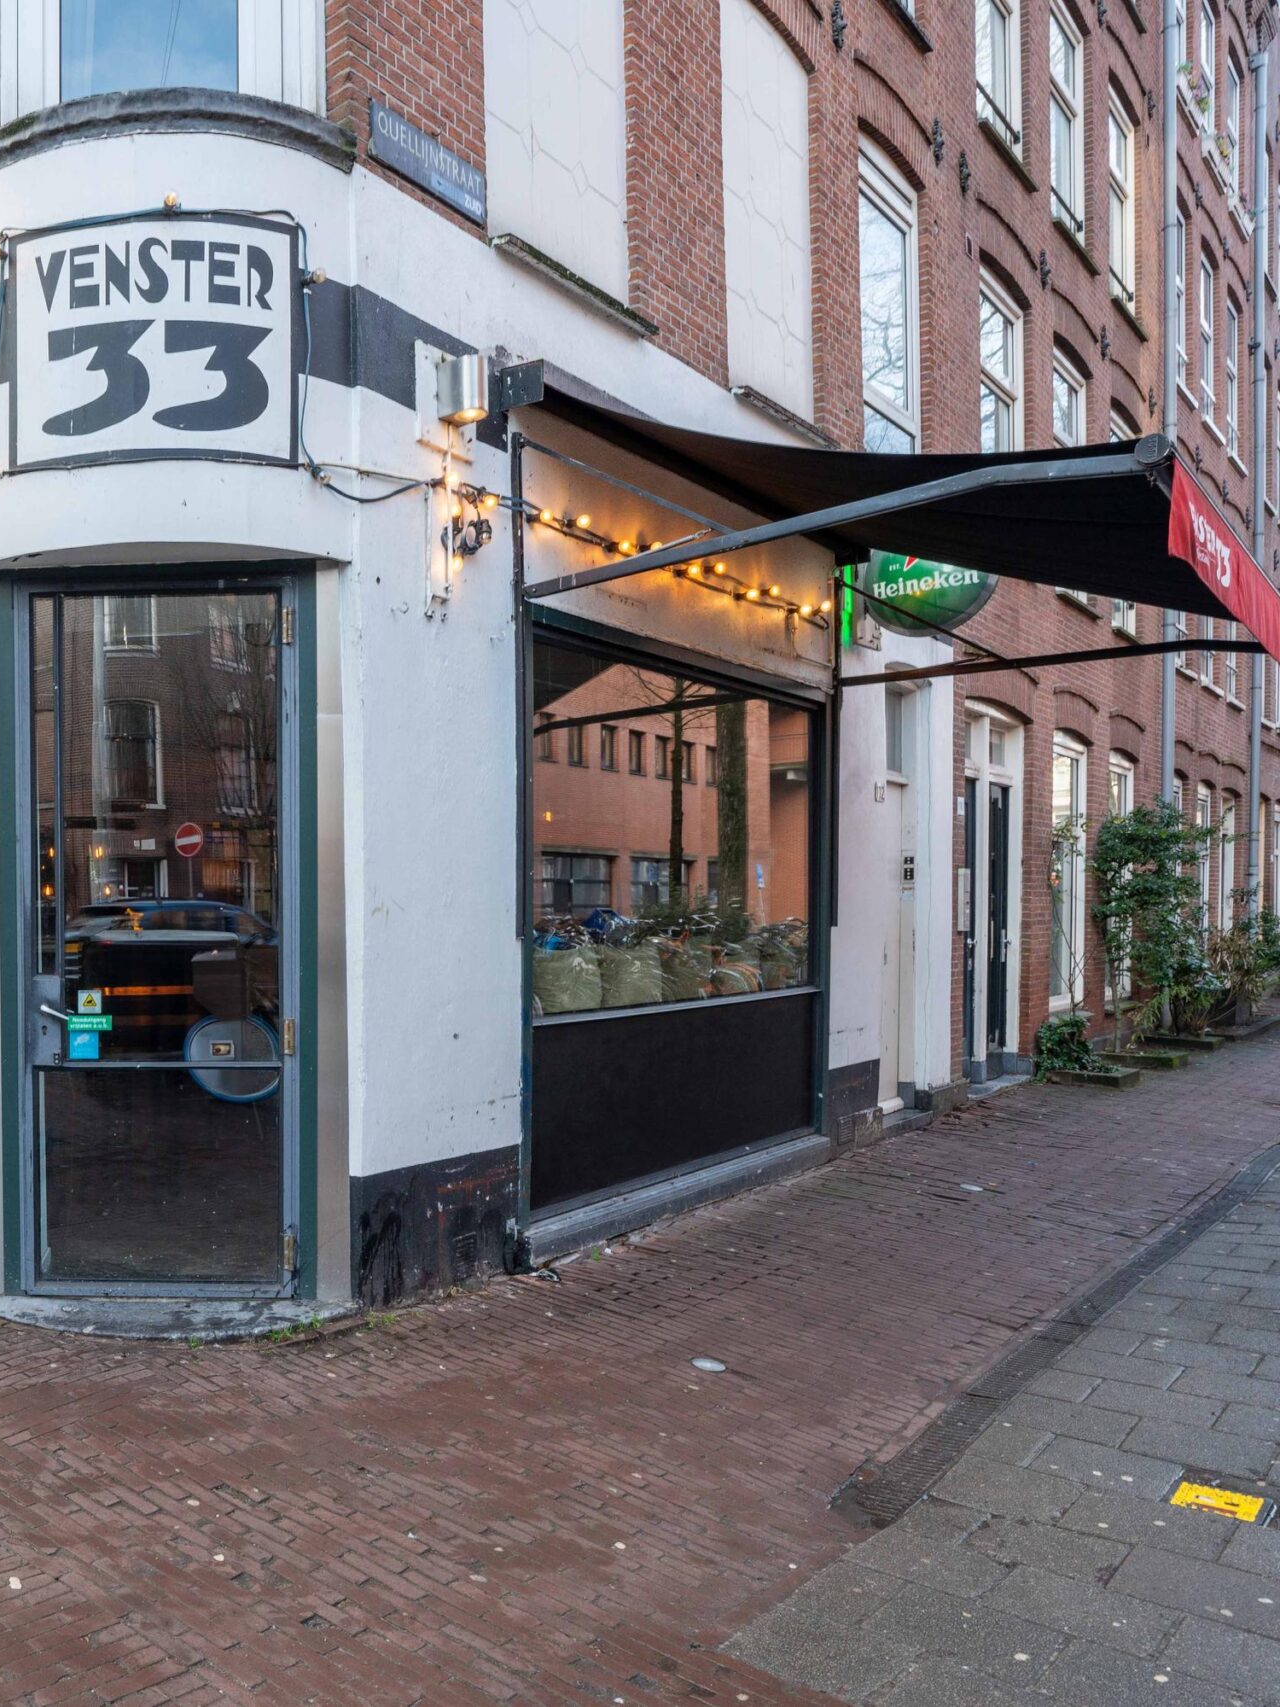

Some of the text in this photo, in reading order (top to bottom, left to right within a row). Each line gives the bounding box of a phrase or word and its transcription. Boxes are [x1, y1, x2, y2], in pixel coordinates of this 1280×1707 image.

[377, 111, 481, 196] QUELLIJNSTRAAT
[464, 194, 482, 216] ZUID
[35, 237, 274, 314] VENSTER
[42, 319, 274, 436] 33
[873, 569, 980, 599] Heineken
